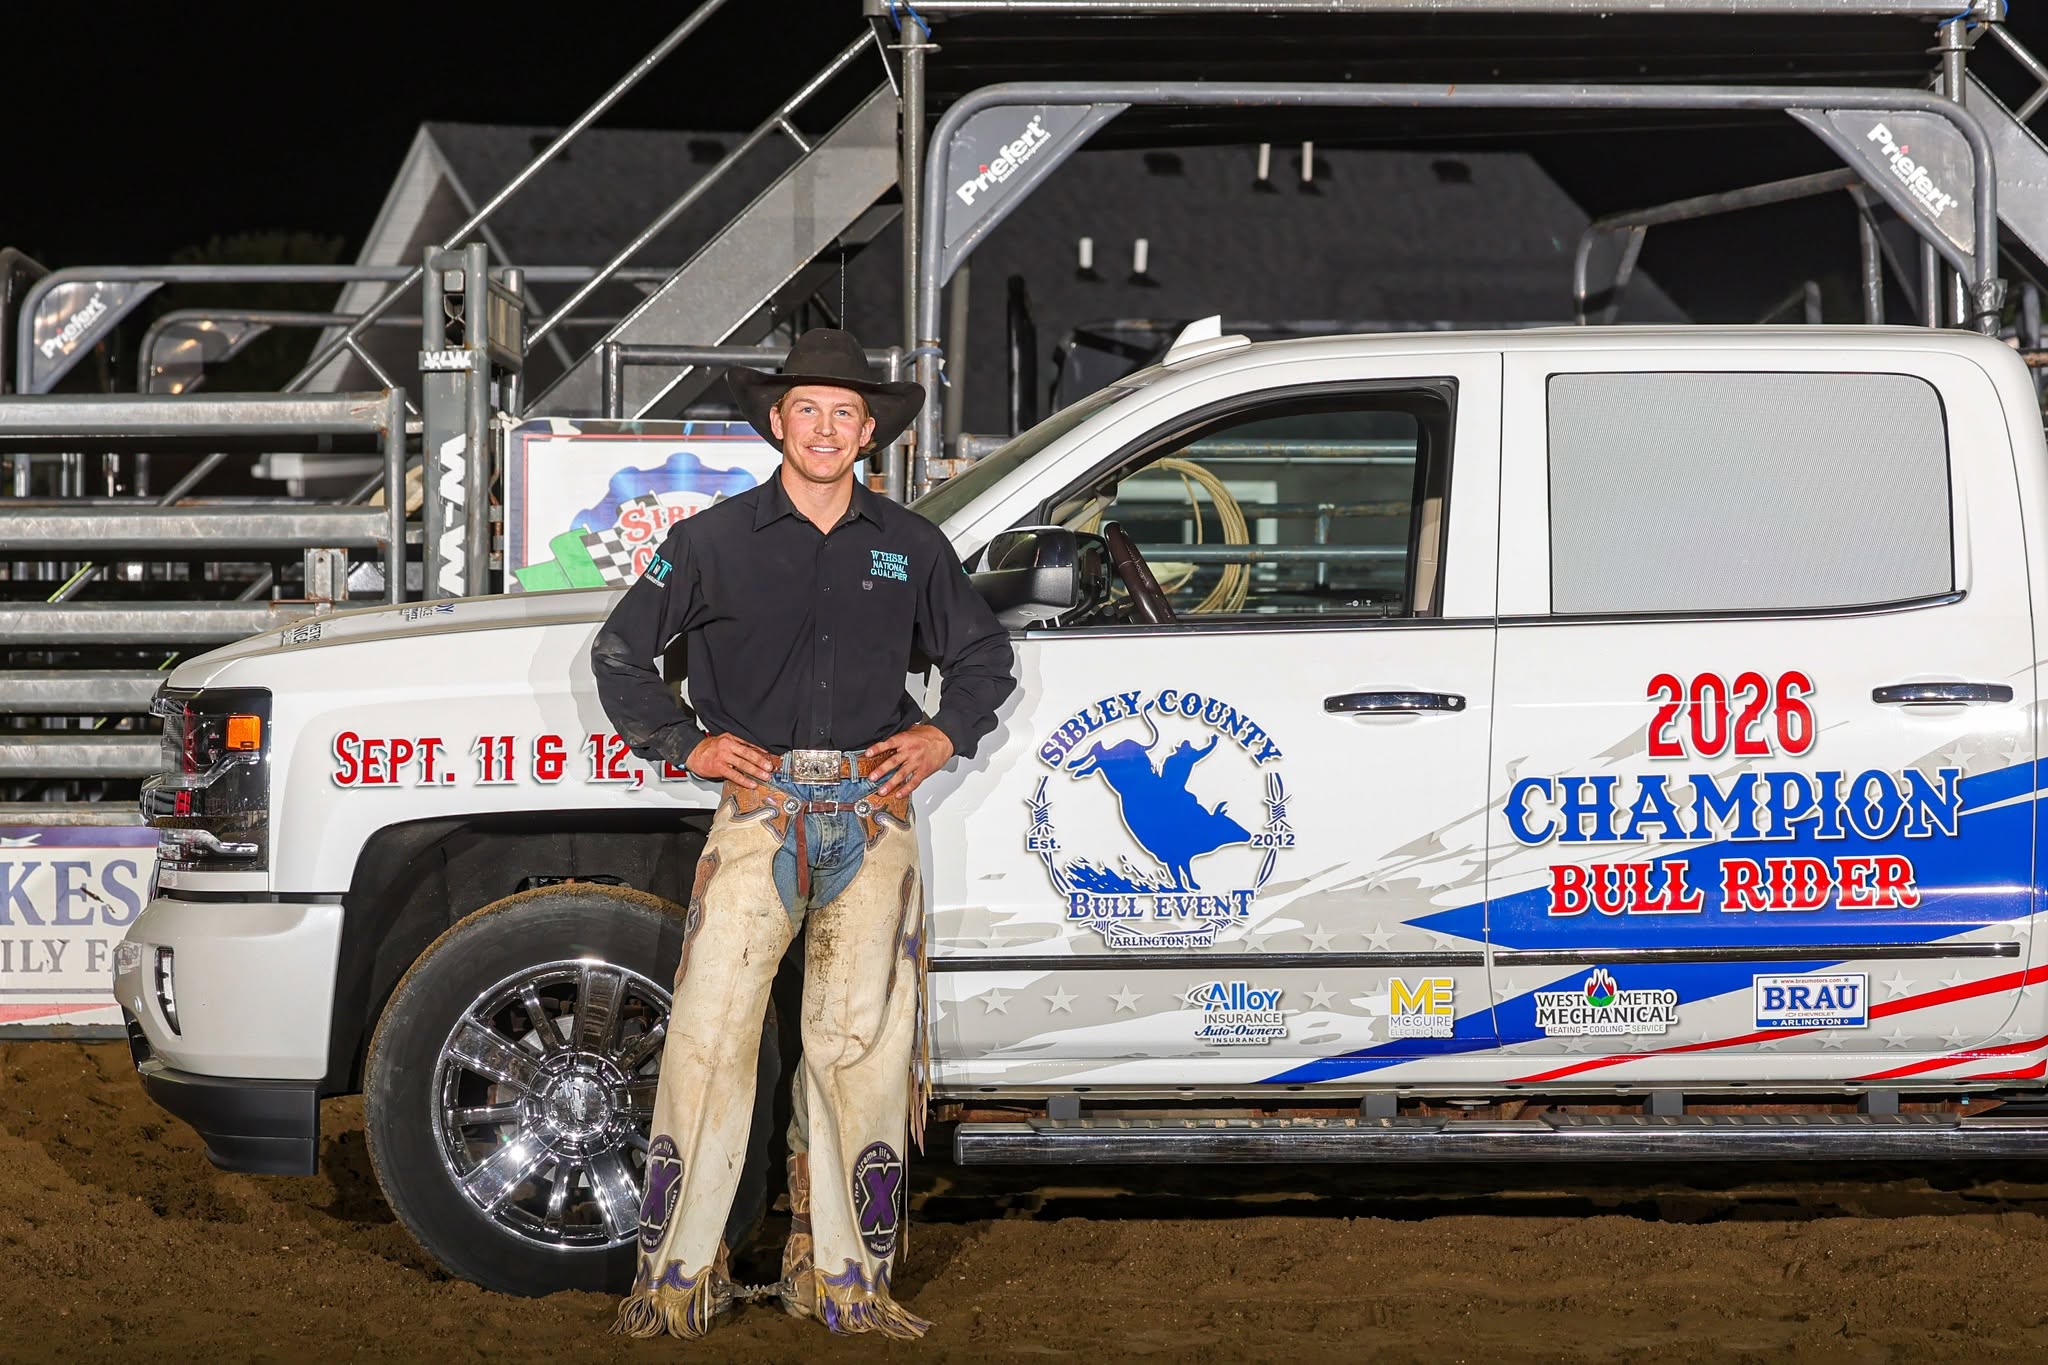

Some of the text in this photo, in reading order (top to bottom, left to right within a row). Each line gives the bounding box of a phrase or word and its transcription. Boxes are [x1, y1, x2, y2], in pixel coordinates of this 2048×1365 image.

[873, 560, 906, 573] NATIONAL
[870, 568, 908, 582] QUALIFIER
[1647, 671, 1815, 757] 2026
[1039, 689, 1284, 768] SIBLEY COUNTY
[333, 730, 457, 787] SEPT.
[476, 734, 519, 785] 11
[536, 735, 567, 784] &
[1503, 768, 1962, 847] CHAMPION
[1028, 833, 1295, 849] Est. 2012
[1549, 855, 1921, 915] BULL RIDER
[1068, 890, 1255, 918] BULL EVENT
[1113, 935, 1212, 947] ARLINGTON, MN
[1204, 983, 1279, 1011] Alloy
[1390, 979, 1452, 1015] ME
[1537, 991, 1675, 1007] WEST METRO
[1763, 985, 1858, 1010] BRAU
[1204, 1013, 1281, 1024] INSURANCE
[1390, 1016, 1452, 1027] MCGUIRE
[1538, 1006, 1676, 1025] MECHANICAL
[1780, 1018, 1842, 1027] ARLINGTON
[1194, 1024, 1286, 1037] Auto-Owners
[1390, 1028, 1431, 1036] ELECTRIC
[1547, 1023, 1664, 1035] HEATING COOLING SERVICE
[1212, 1036, 1267, 1044] INSURANCE
